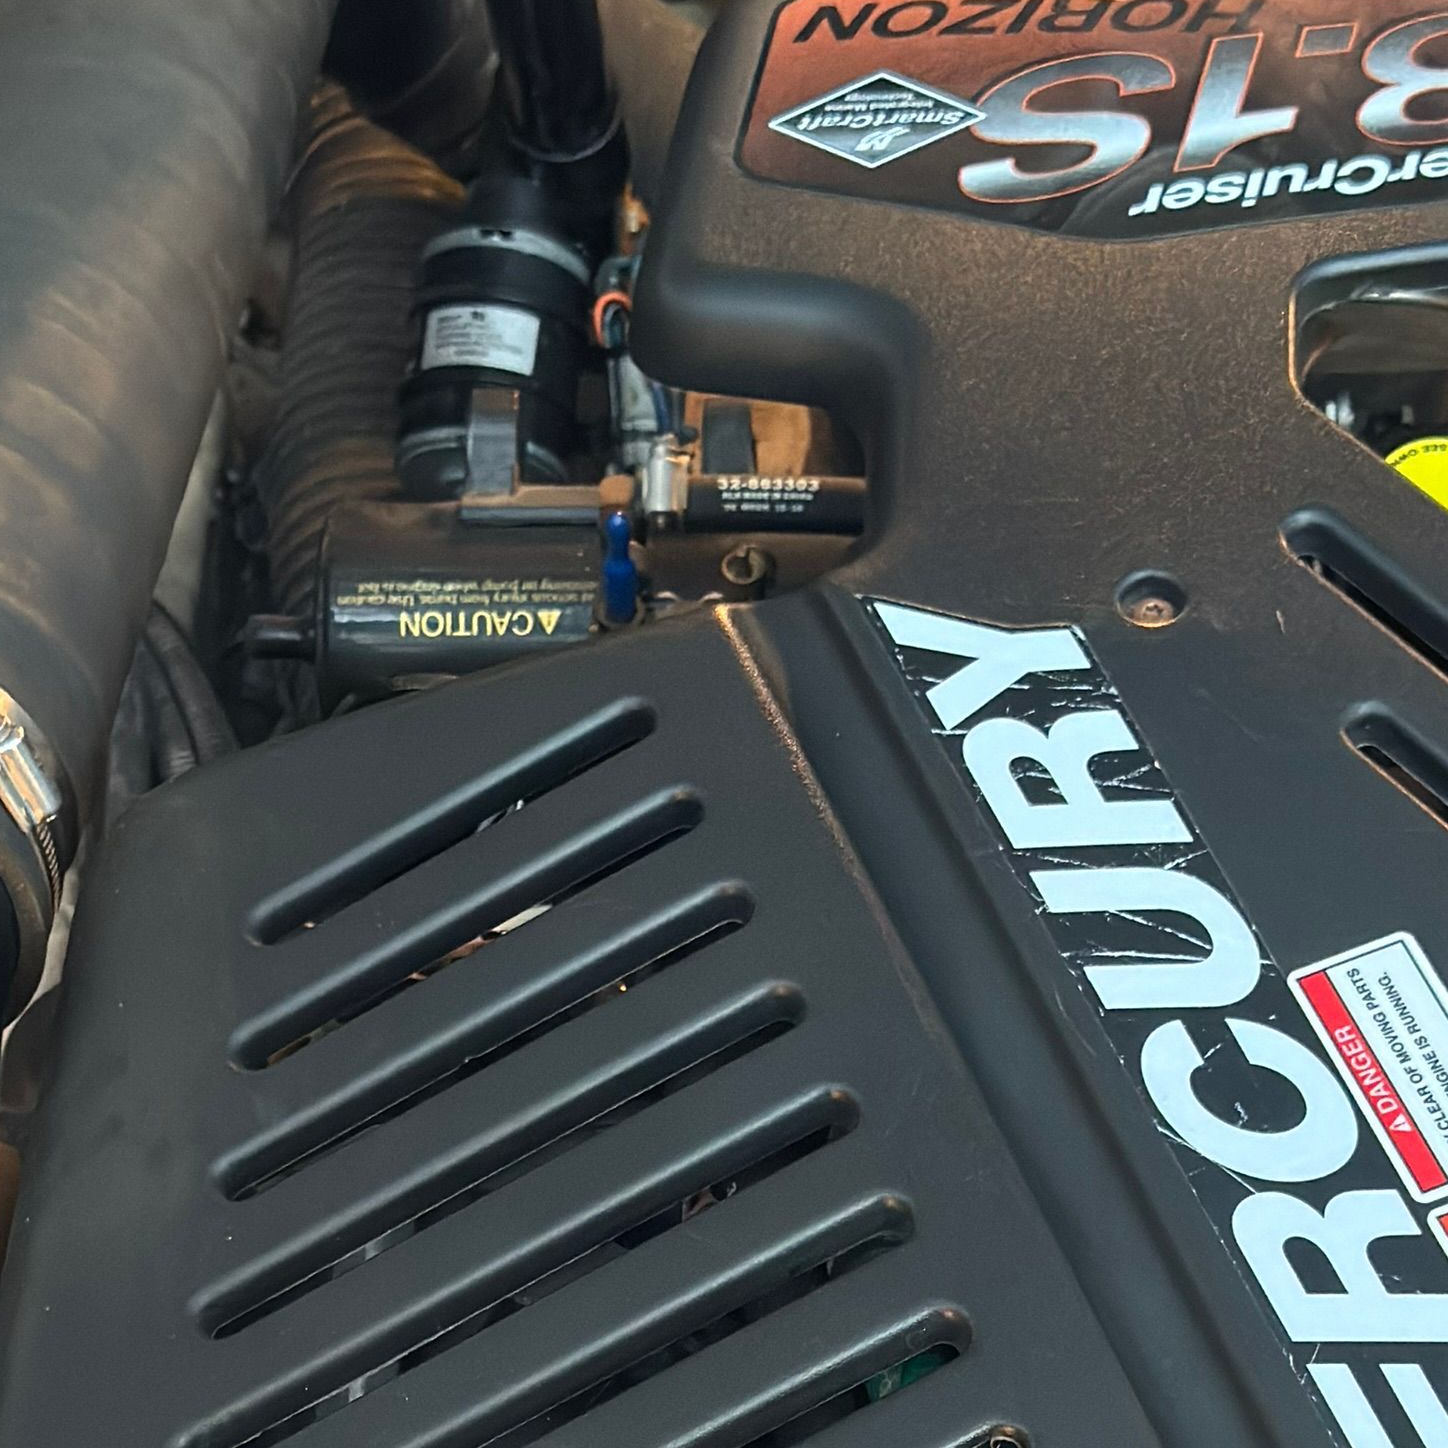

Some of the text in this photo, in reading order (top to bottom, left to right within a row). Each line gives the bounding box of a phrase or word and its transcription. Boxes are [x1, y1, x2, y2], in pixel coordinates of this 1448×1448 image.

[796, 111, 964, 130] SmartCraft
[400, 610, 534, 637] CAUTION
[1345, 966, 1381, 1010] PARTS
[1374, 971, 1422, 1035] RUNNING.
[1371, 1010, 1413, 1064] MOVING
[1412, 1034, 1431, 1050] IS
[1332, 1024, 1399, 1114] DANGER
[1403, 1064, 1425, 1084] OF
